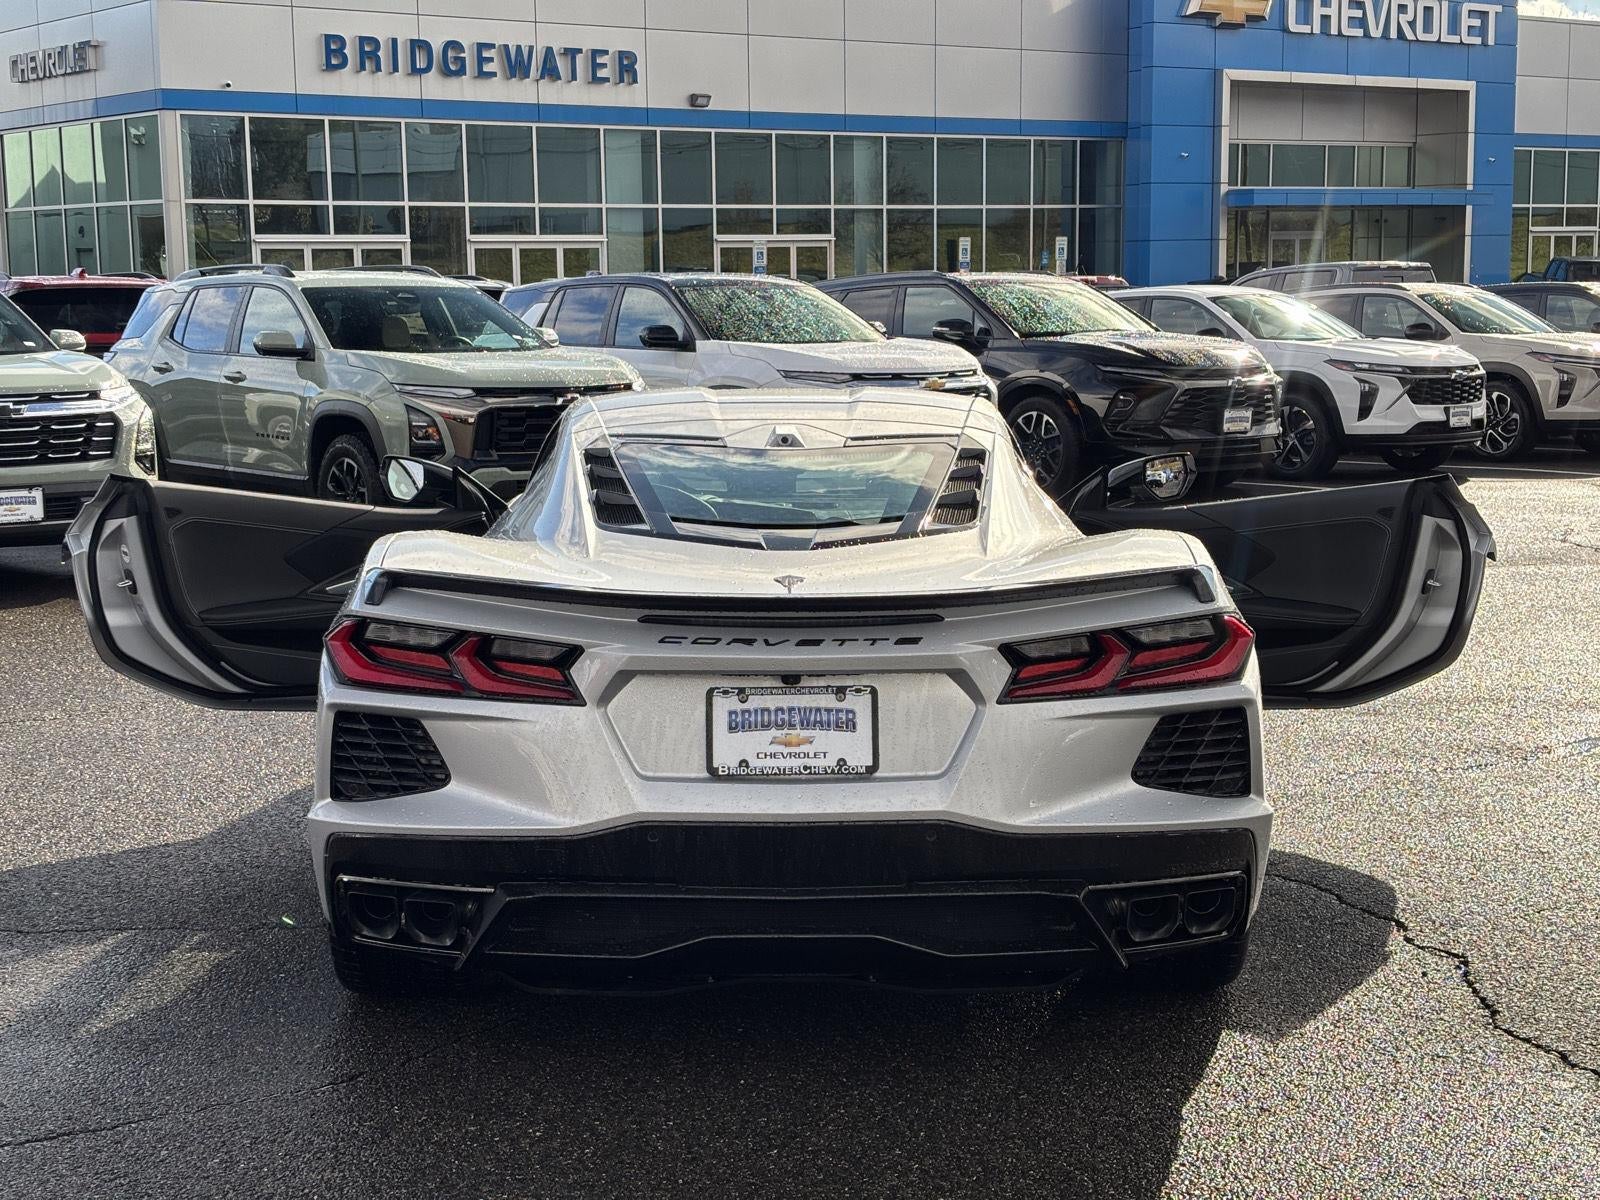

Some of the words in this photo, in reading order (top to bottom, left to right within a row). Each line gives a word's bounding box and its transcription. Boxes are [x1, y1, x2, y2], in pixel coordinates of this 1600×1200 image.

[1287, 0, 1503, 46] CHEVROLET
[9, 40, 101, 83] CHEVROLET
[321, 32, 639, 86] BRIDGEWATER
[657, 636, 924, 647] CORVETTE
[745, 687, 837, 696] BRIDGEWATERCHEVROLET
[727, 705, 858, 734] BRIDGEWATER
[756, 751, 829, 760] CHEVROLET
[718, 764, 867, 775] BRIDGEWATERCHEVY.COM
